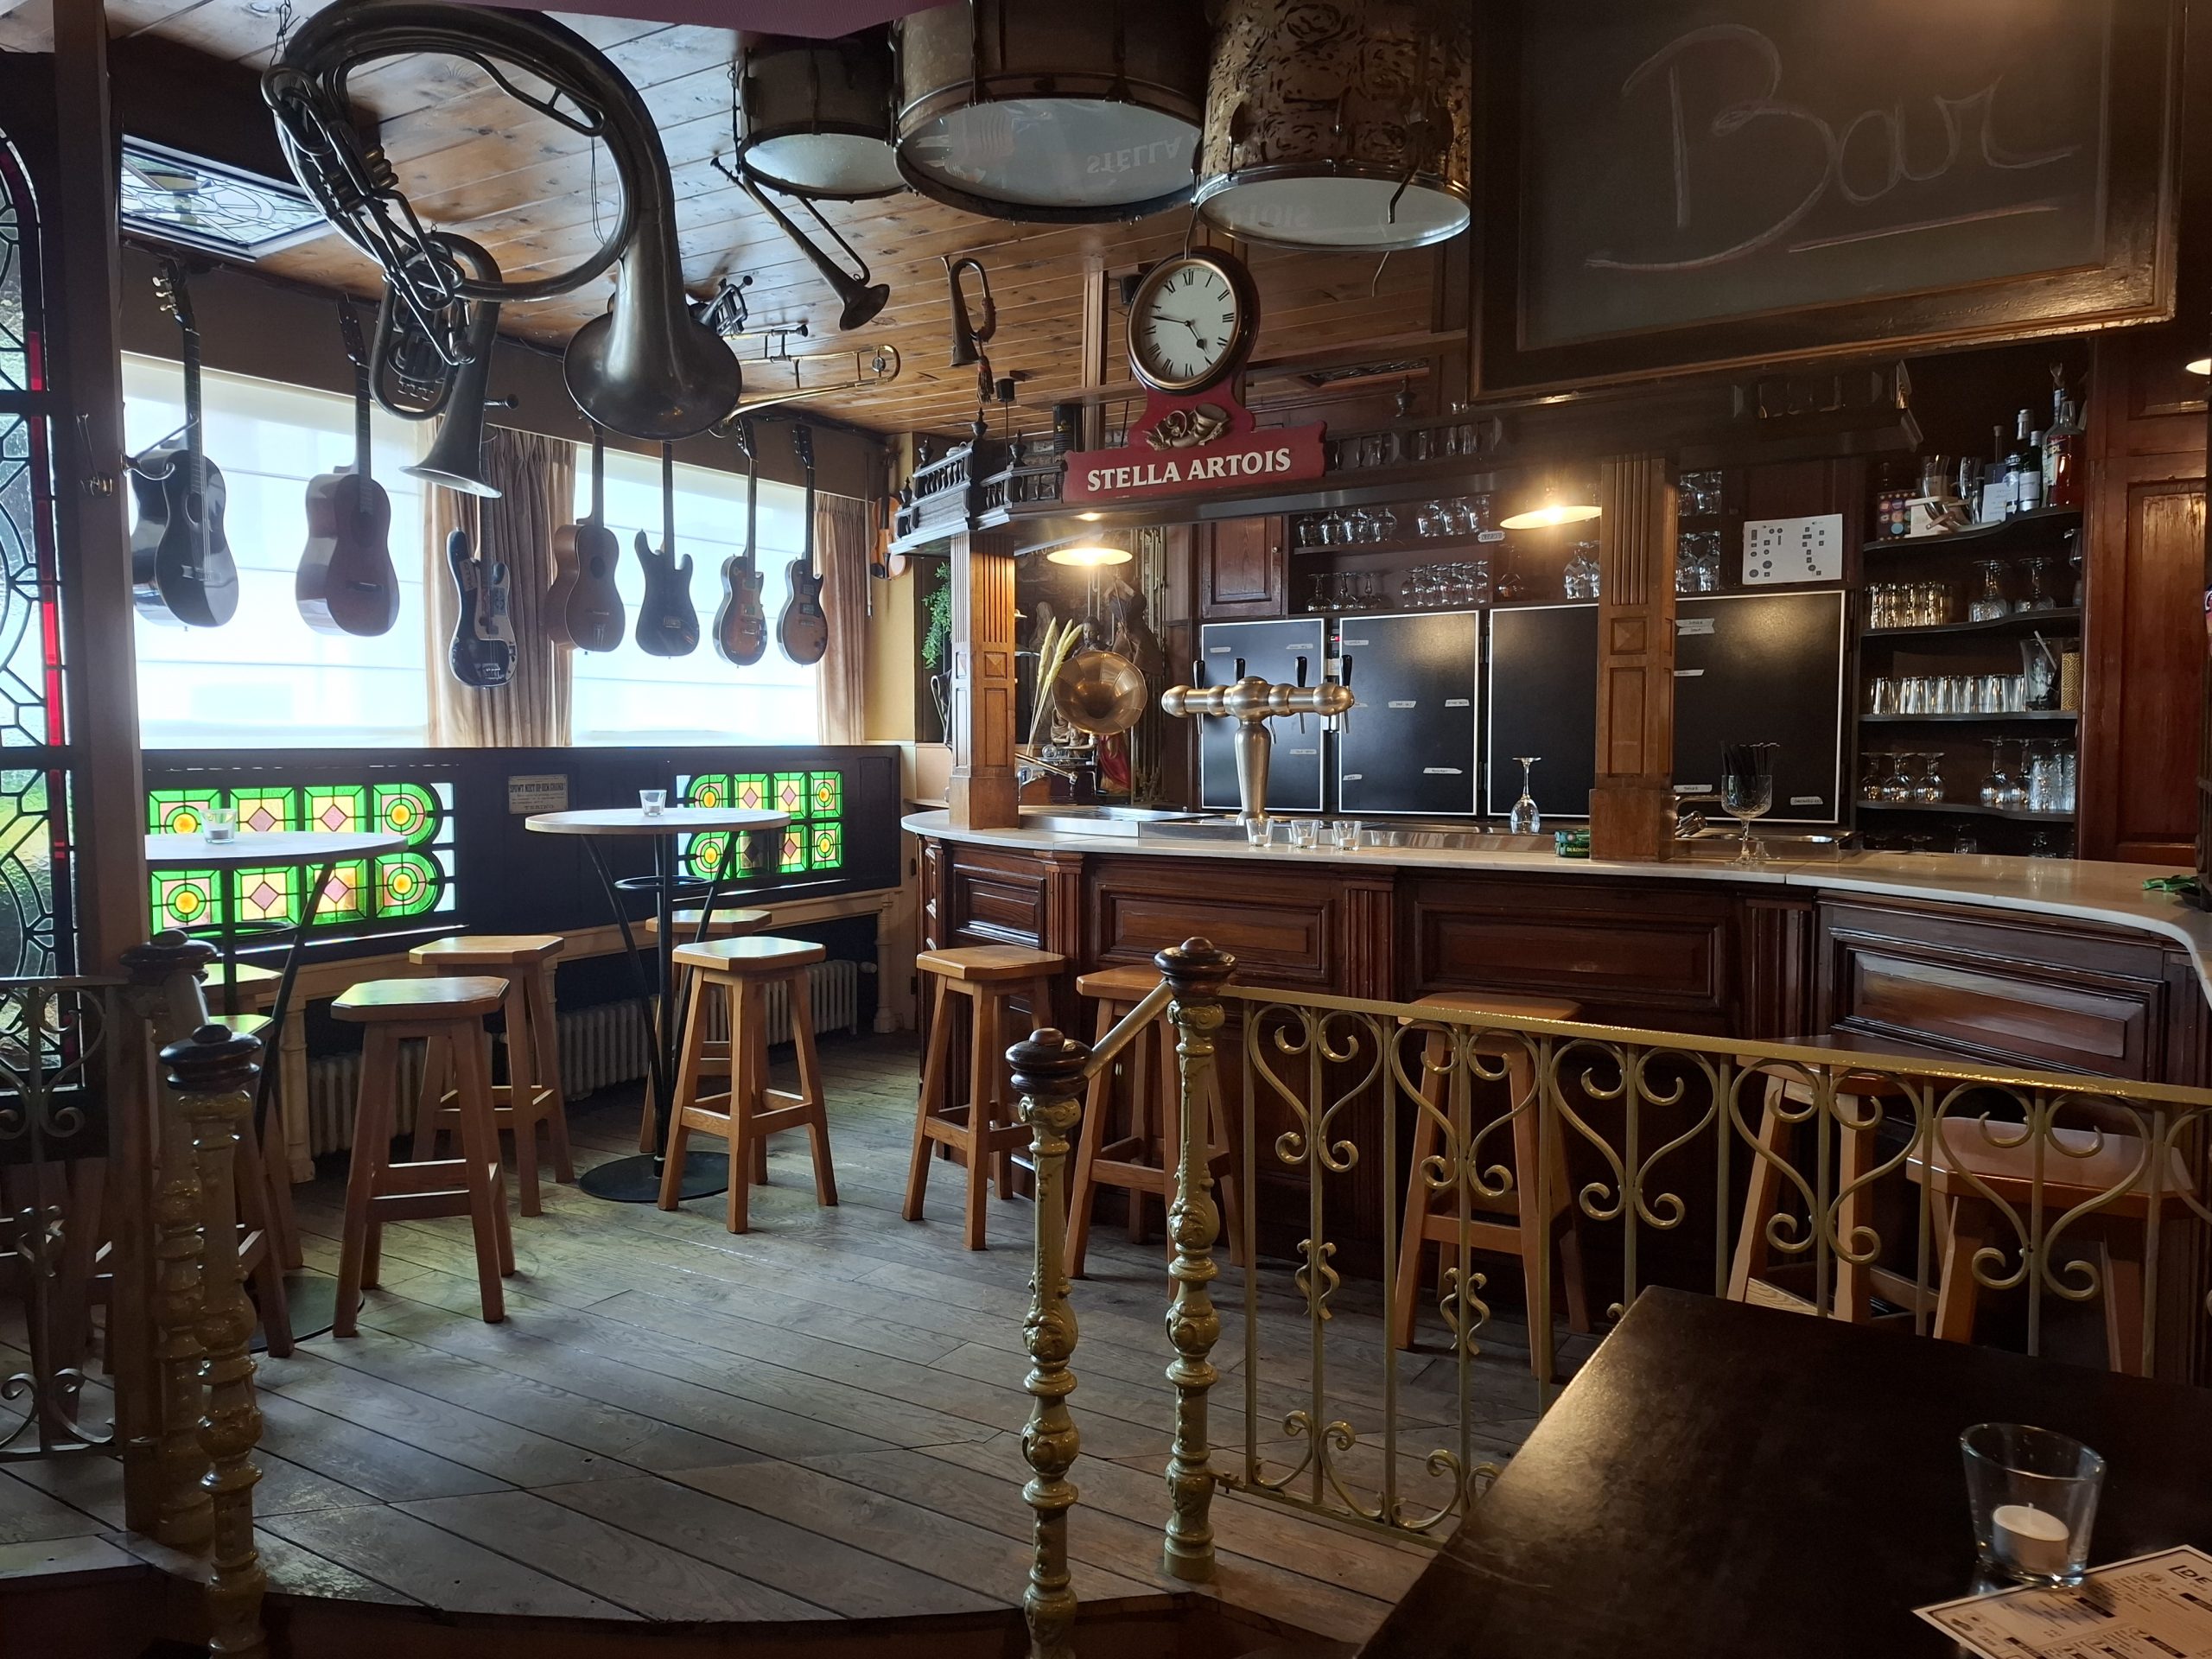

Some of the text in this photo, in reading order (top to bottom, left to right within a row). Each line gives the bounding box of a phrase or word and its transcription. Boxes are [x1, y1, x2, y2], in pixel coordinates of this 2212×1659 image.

[1585, 23, 2083, 271] Bar
[1087, 448, 1292, 492] STELLA ARTOIS
